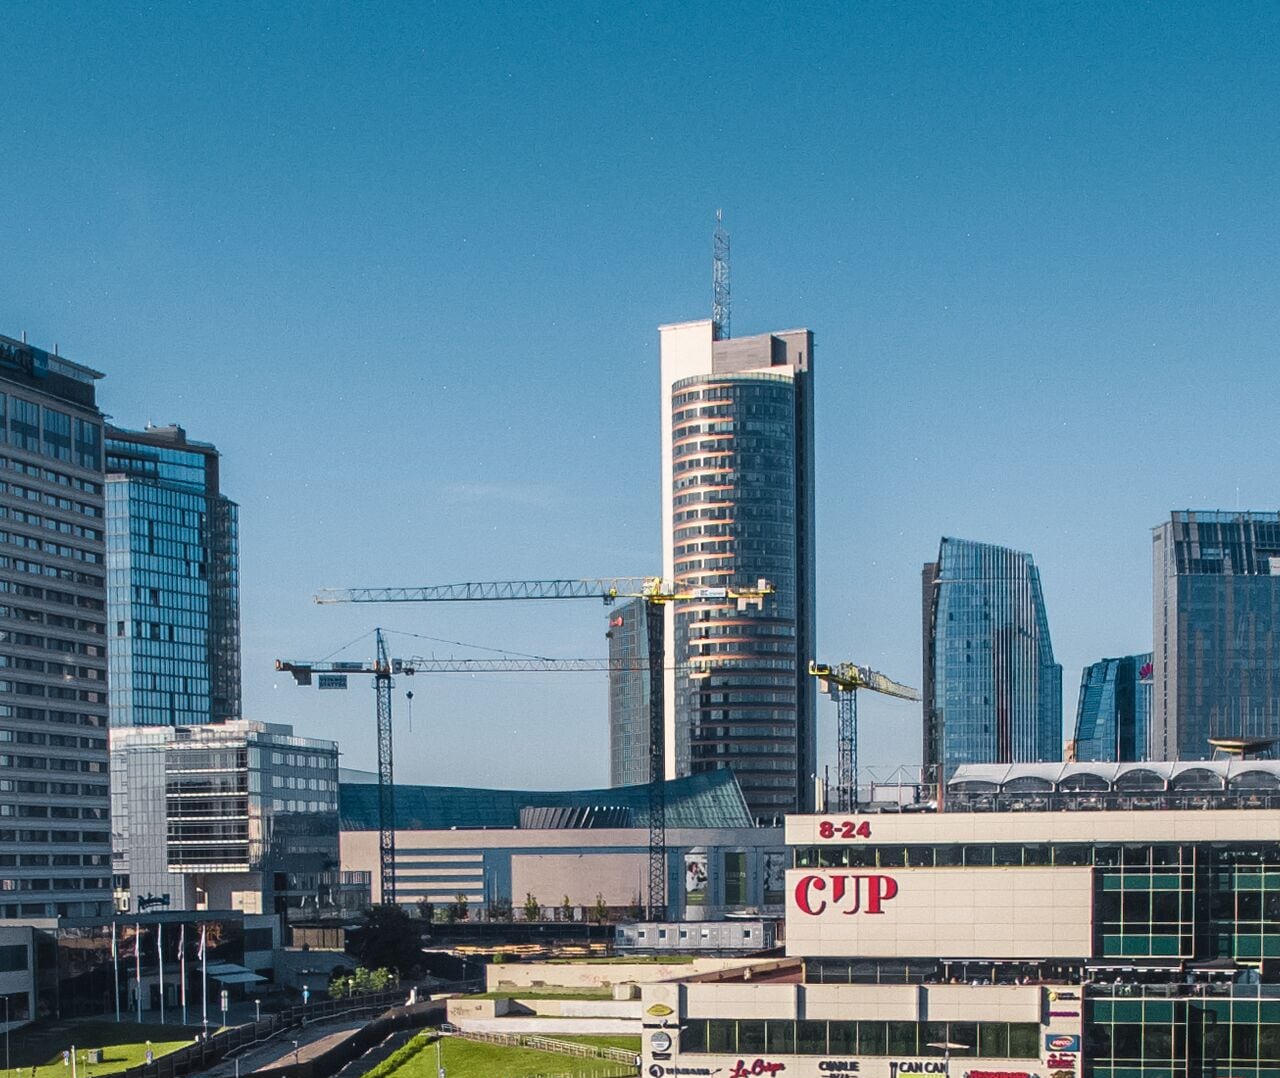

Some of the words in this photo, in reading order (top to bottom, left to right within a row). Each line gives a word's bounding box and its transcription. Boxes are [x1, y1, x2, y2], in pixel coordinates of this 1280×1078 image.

[819, 821, 872, 839] 8-24
[794, 875, 899, 916] CUP
[899, 1062, 923, 1074] CAN
